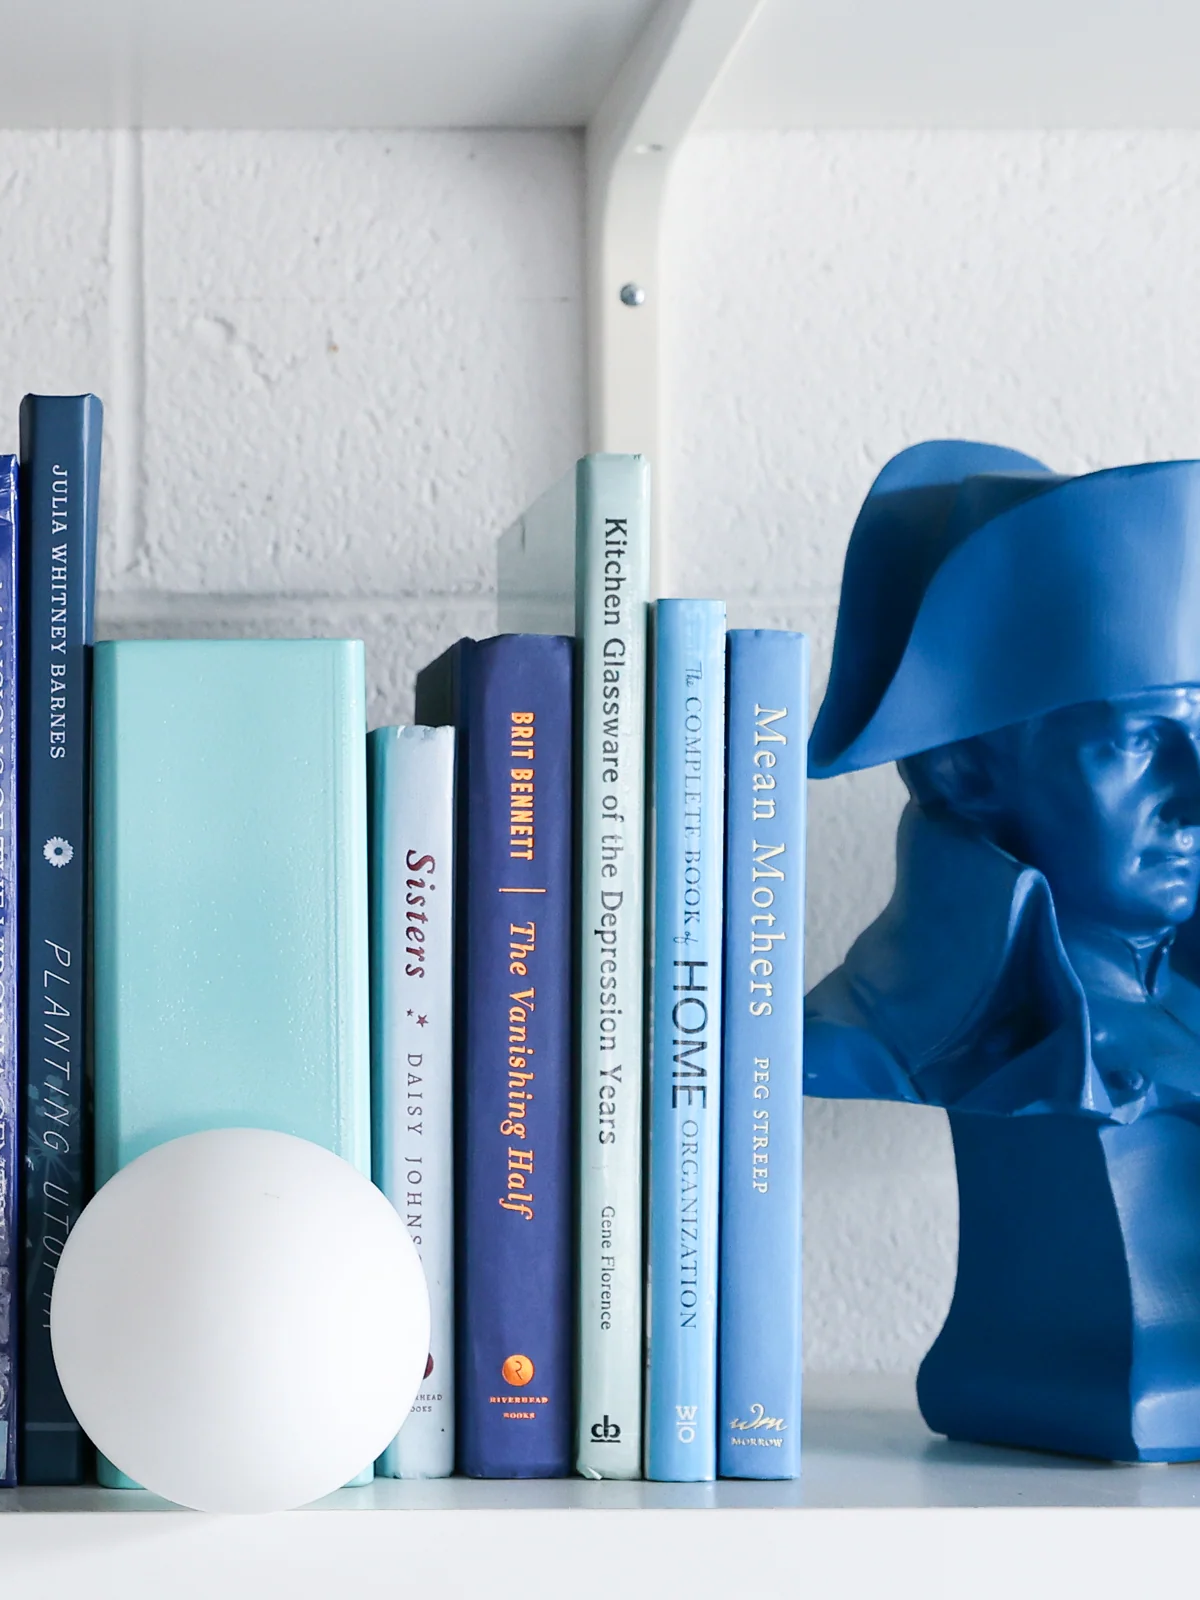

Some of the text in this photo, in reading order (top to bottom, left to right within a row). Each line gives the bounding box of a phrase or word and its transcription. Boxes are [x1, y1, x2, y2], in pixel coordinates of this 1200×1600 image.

[50, 464, 68, 760] JULIA WHITNEY BARNES
[510, 712, 534, 861] BRIT BENNETT
[595, 517, 628, 1146] Kitchen Glassware of the Depression Years
[750, 703, 788, 1016] Mean Mothers
[405, 849, 435, 978] Sisters
[672, 661, 708, 1330] The COMPLETE BOOK of HOME ORGANIZATION
[43, 939, 71, 1328] PLANTING UTO
[405, 1053, 423, 1261] DAISY JOHNS
[499, 922, 534, 1220] The Vanishing Half
[752, 1057, 770, 1194] PEG STREEP
[600, 1206, 615, 1331] Gene Florence
[731, 1437, 784, 1447] MORROW
